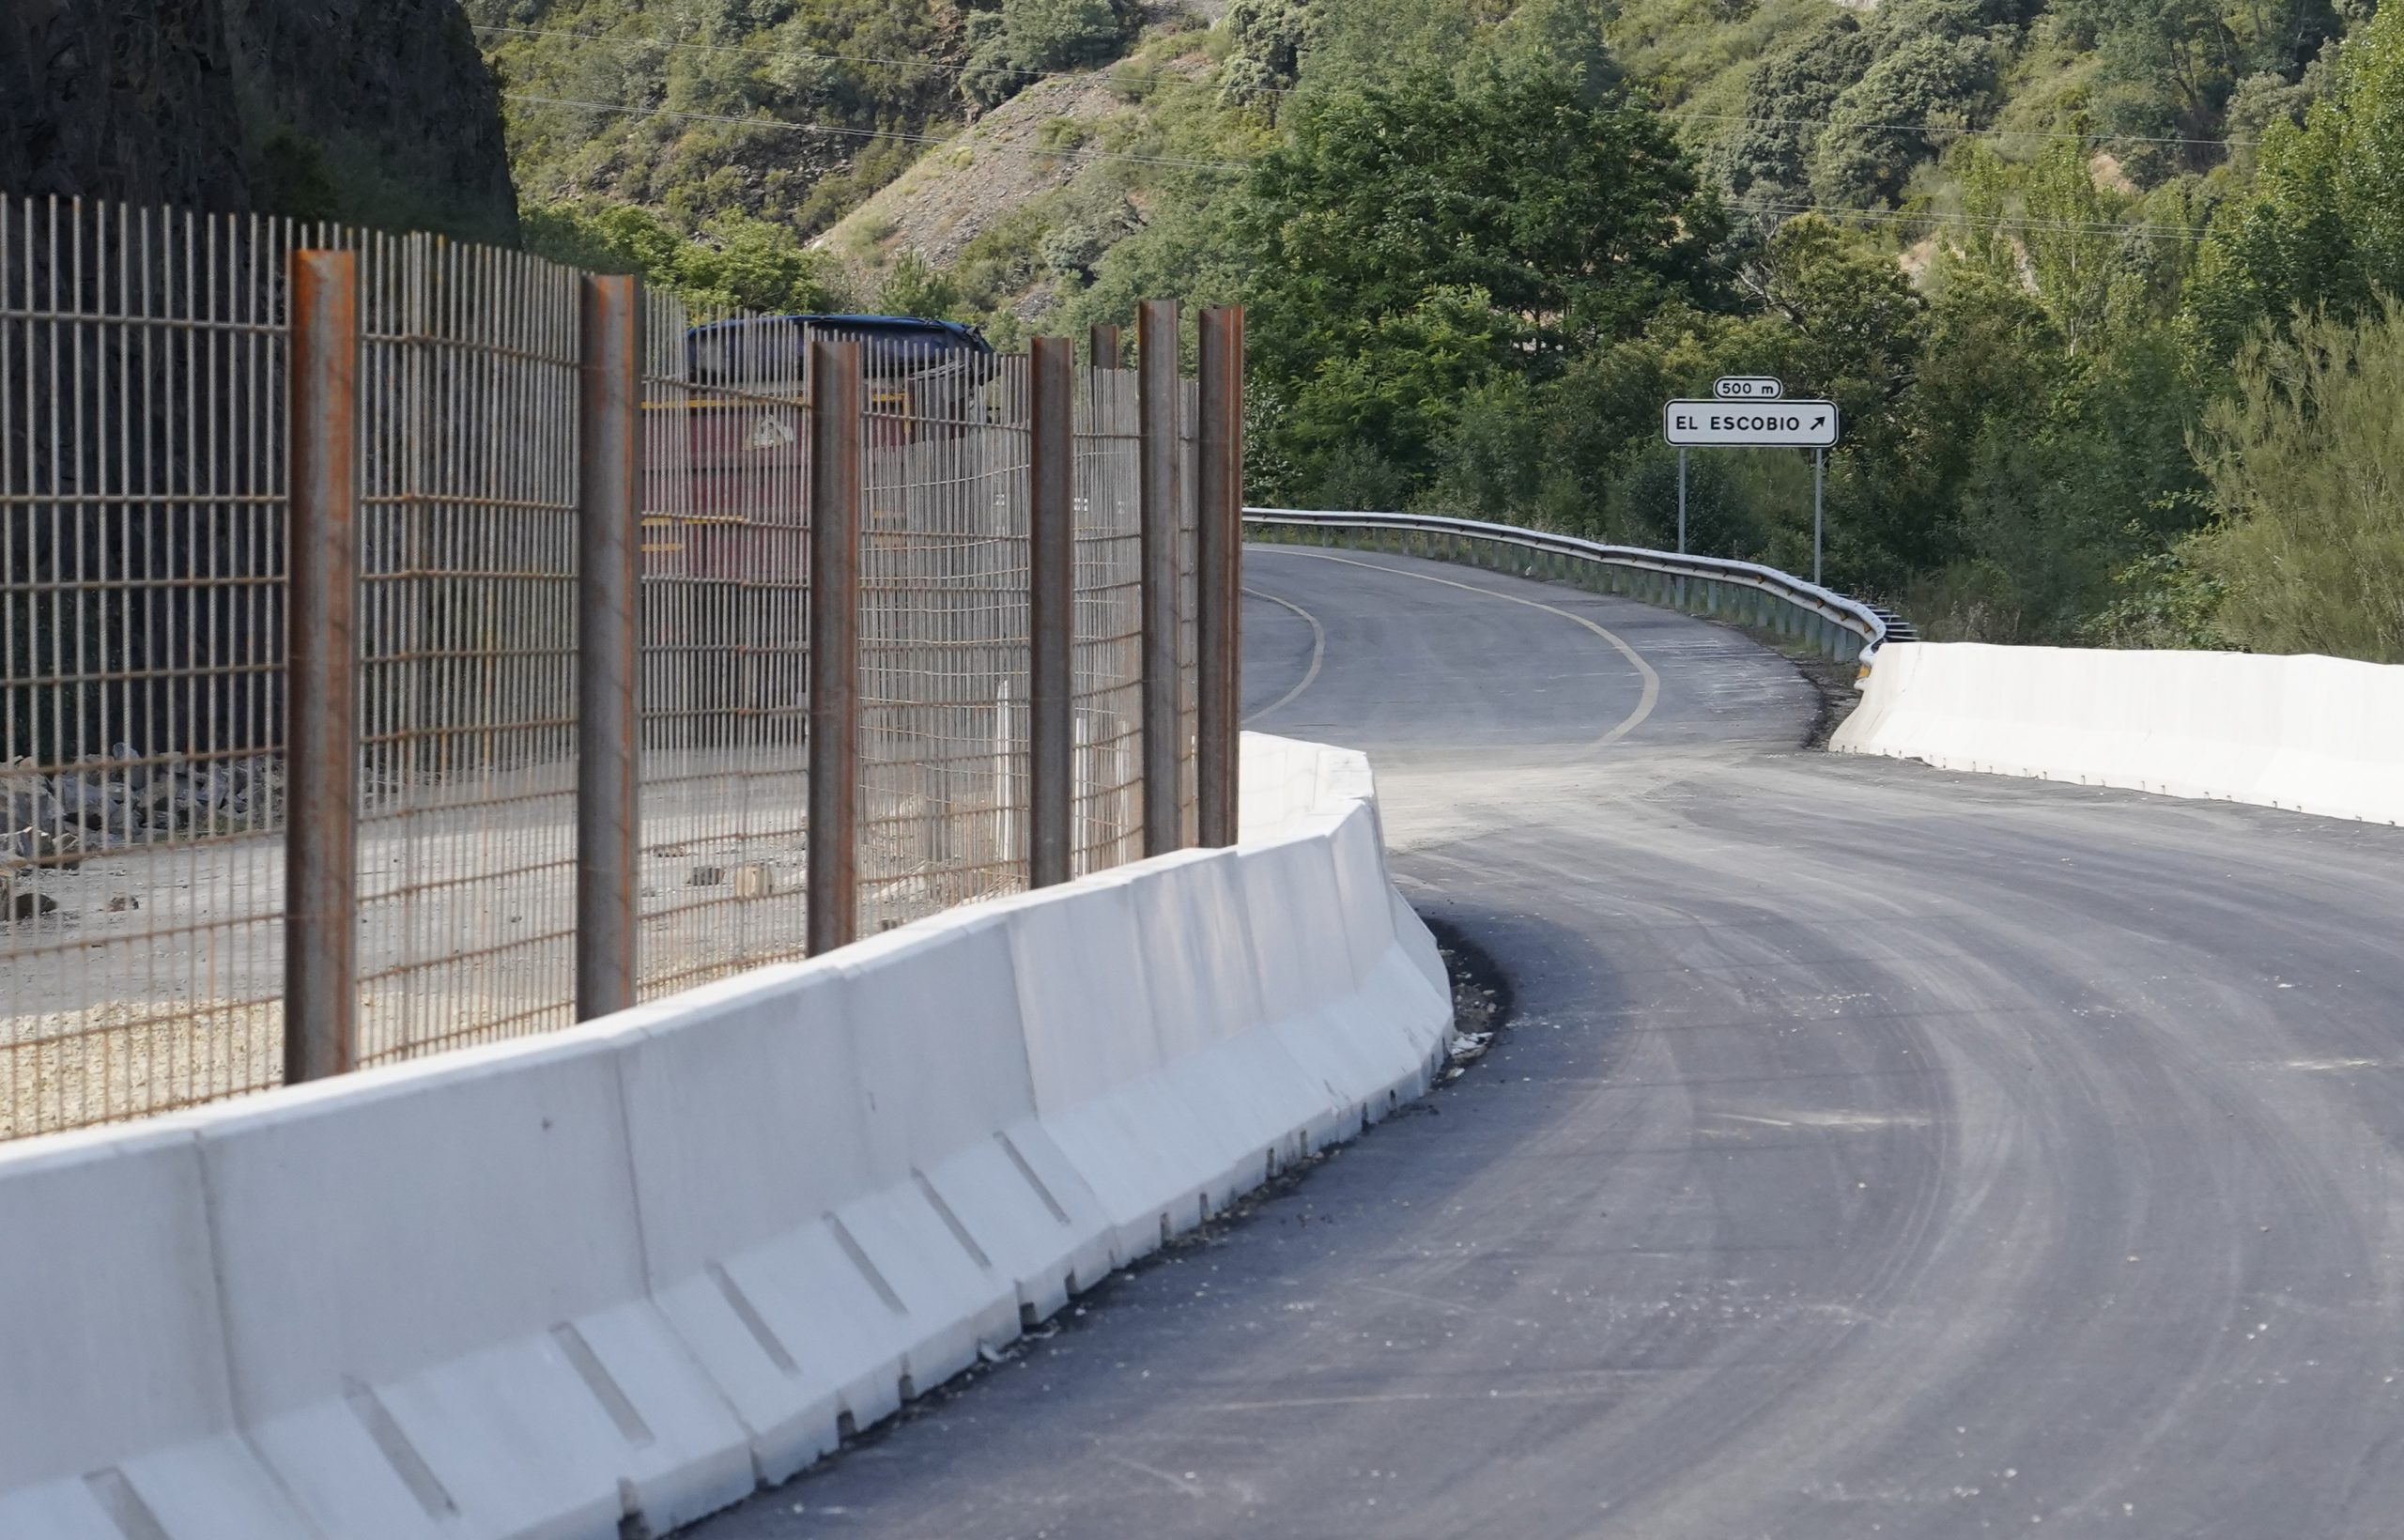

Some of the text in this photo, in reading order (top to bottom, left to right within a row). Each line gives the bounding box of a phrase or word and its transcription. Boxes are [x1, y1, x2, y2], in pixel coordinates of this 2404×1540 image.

[1722, 383, 1774, 394] 500 m
[1676, 416, 1800, 431] EL ESCOBIO
